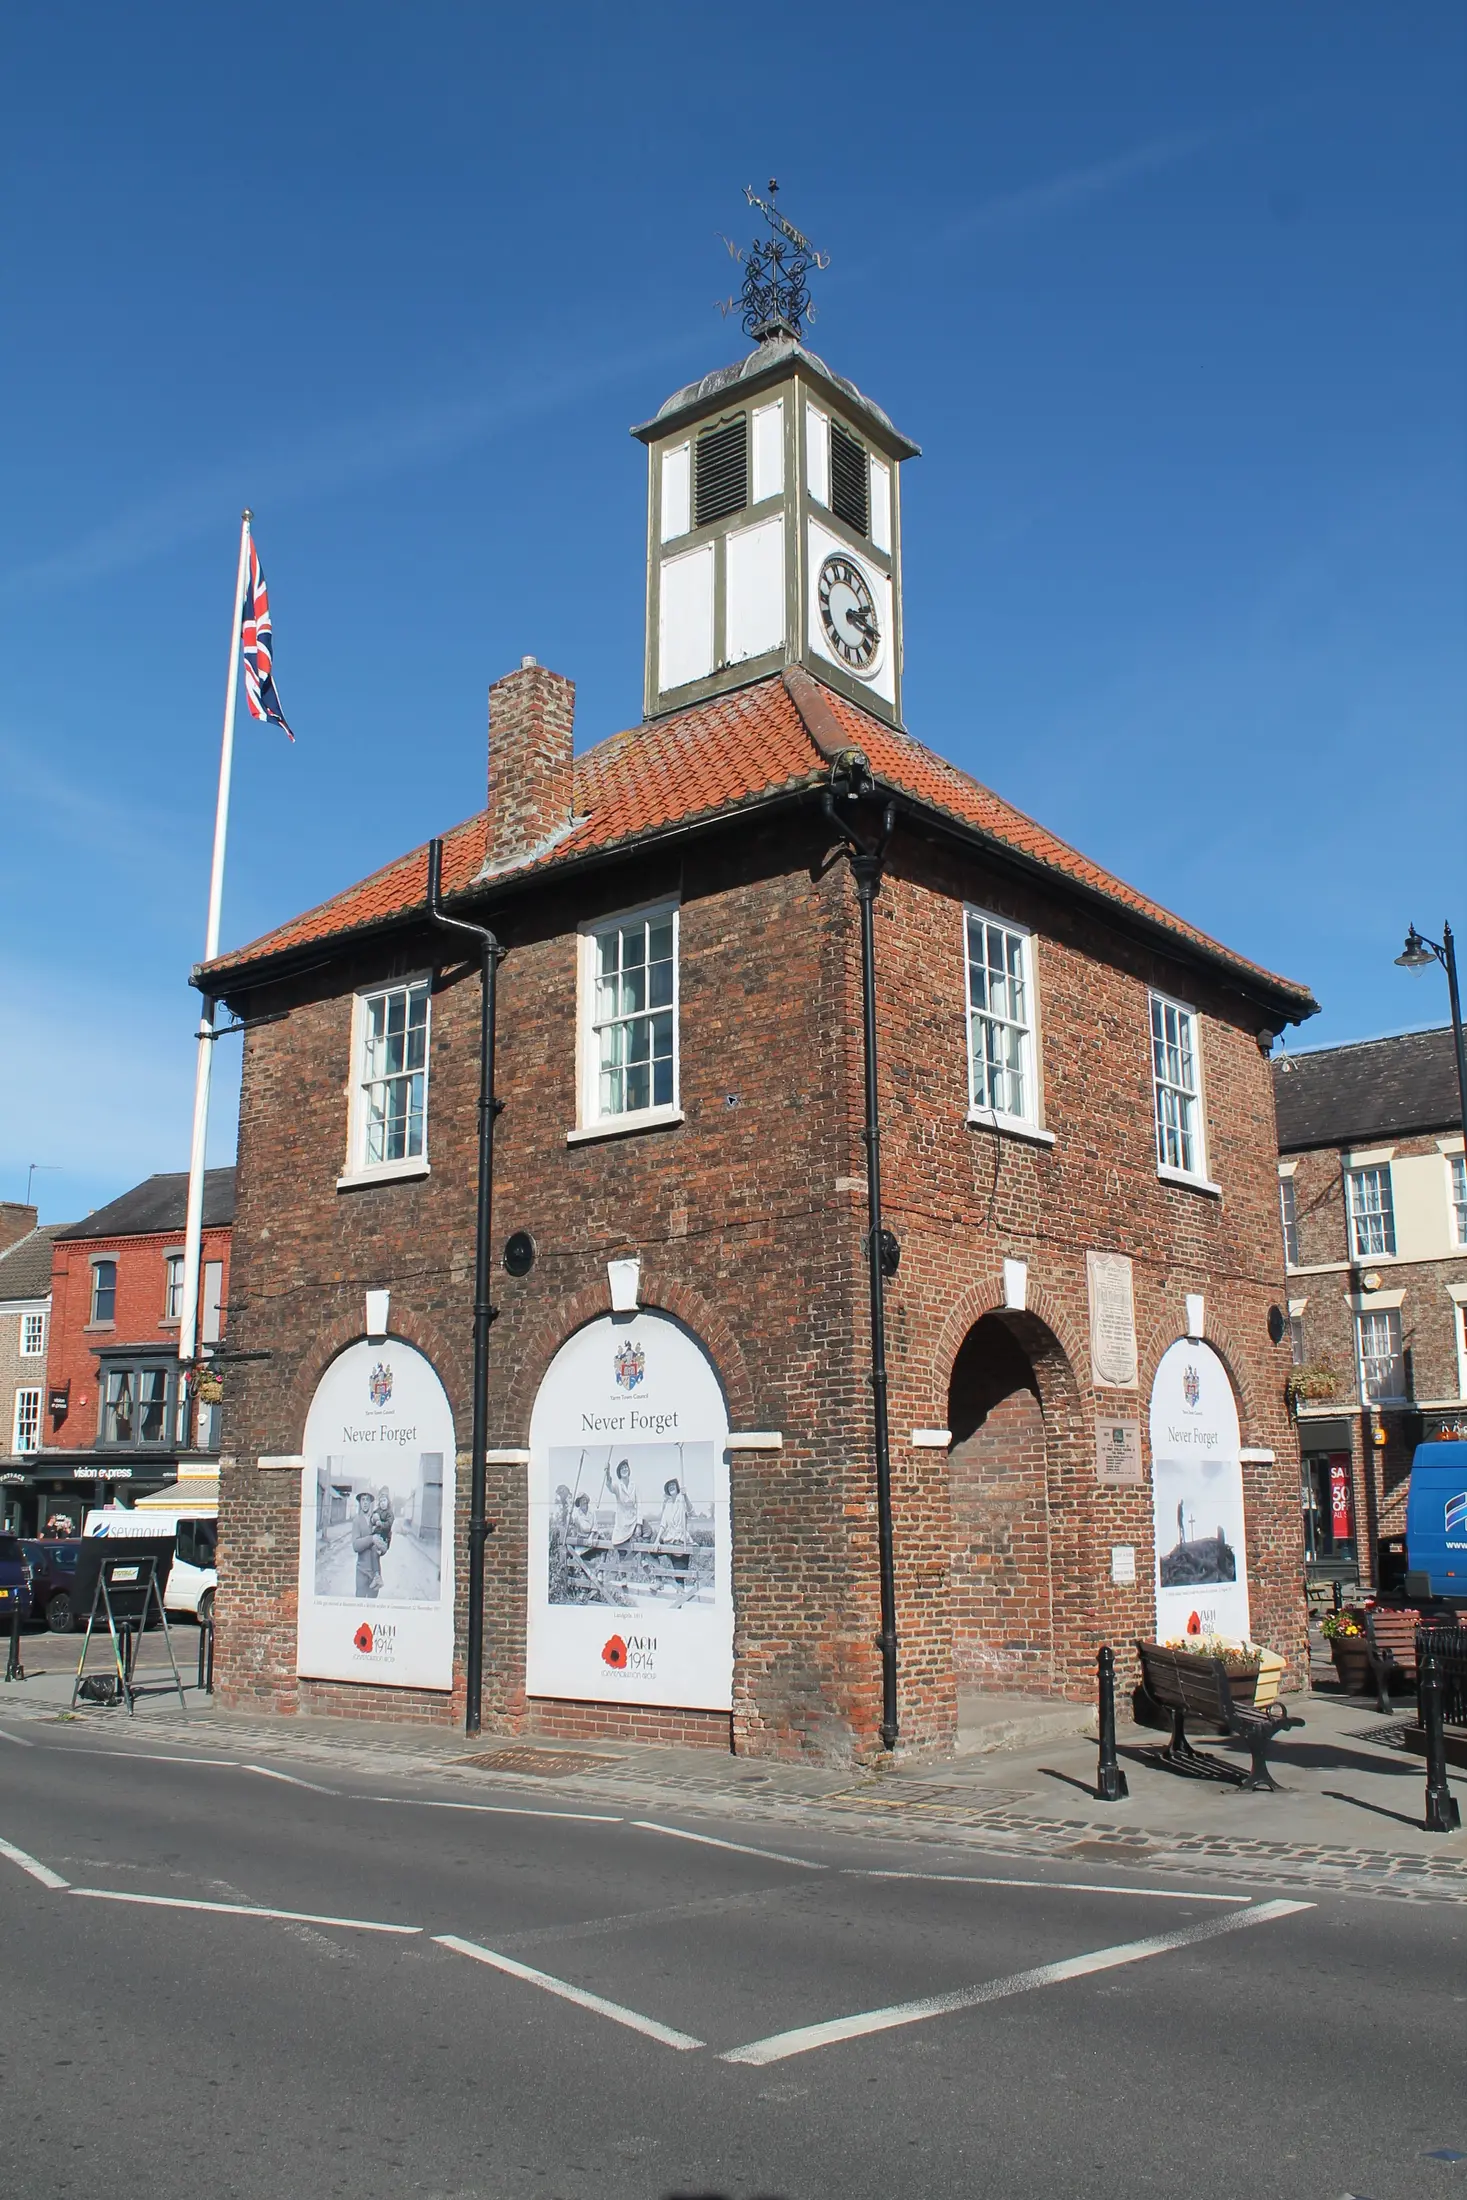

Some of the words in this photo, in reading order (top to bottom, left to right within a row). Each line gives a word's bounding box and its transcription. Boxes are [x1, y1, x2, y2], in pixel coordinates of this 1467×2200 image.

[581, 1413, 625, 1431] Never
[630, 1411, 678, 1434] Forget
[343, 1427, 377, 1442] Never
[380, 1425, 417, 1446] Forget
[1168, 1426, 1192, 1443] Never
[1193, 1427, 1218, 1449] Forget
[74, 1466, 97, 1478] vision
[374, 1638, 393, 1653] 1914
[624, 1636, 657, 1650] YARM
[628, 1652, 654, 1670] 1914
